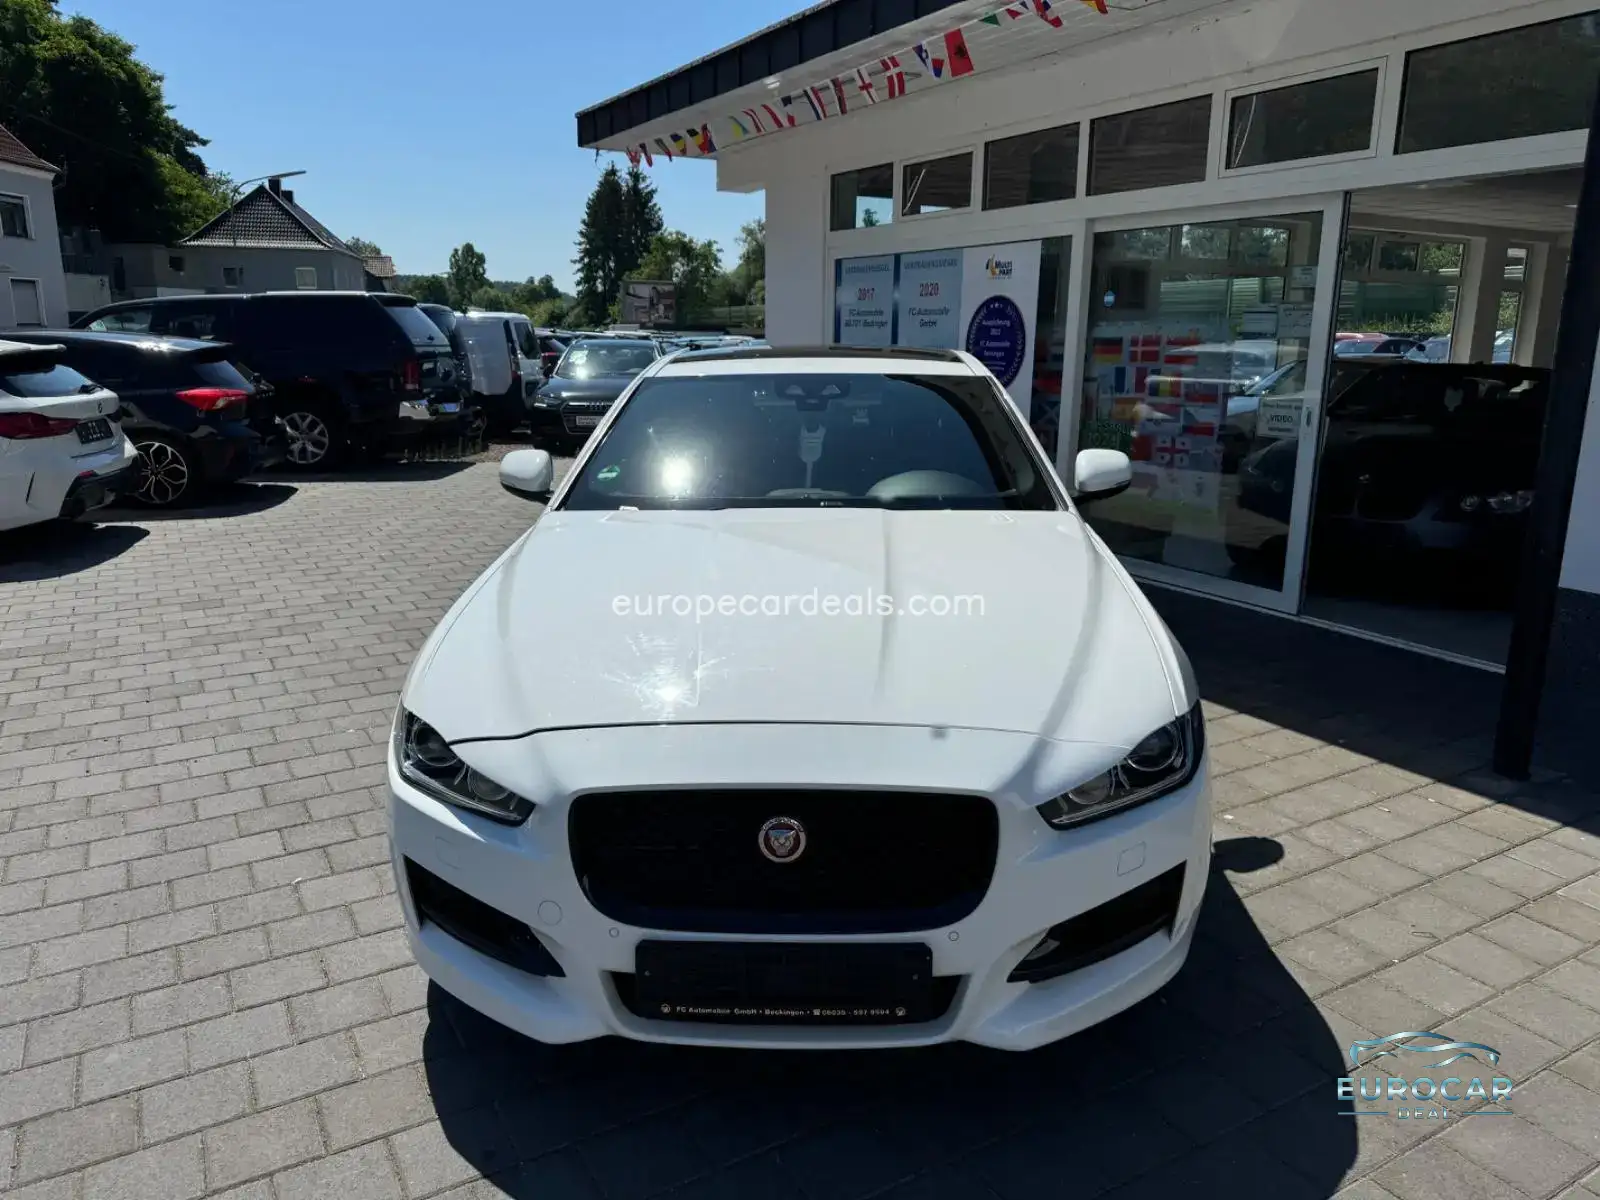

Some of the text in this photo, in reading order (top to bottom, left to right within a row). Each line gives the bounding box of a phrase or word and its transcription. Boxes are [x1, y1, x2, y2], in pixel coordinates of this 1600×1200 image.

[858, 287, 875, 301] 2017
[919, 282, 939, 297] 2020
[1270, 414, 1293, 423] VIDEO
[734, 1007, 757, 1015] GmbH
